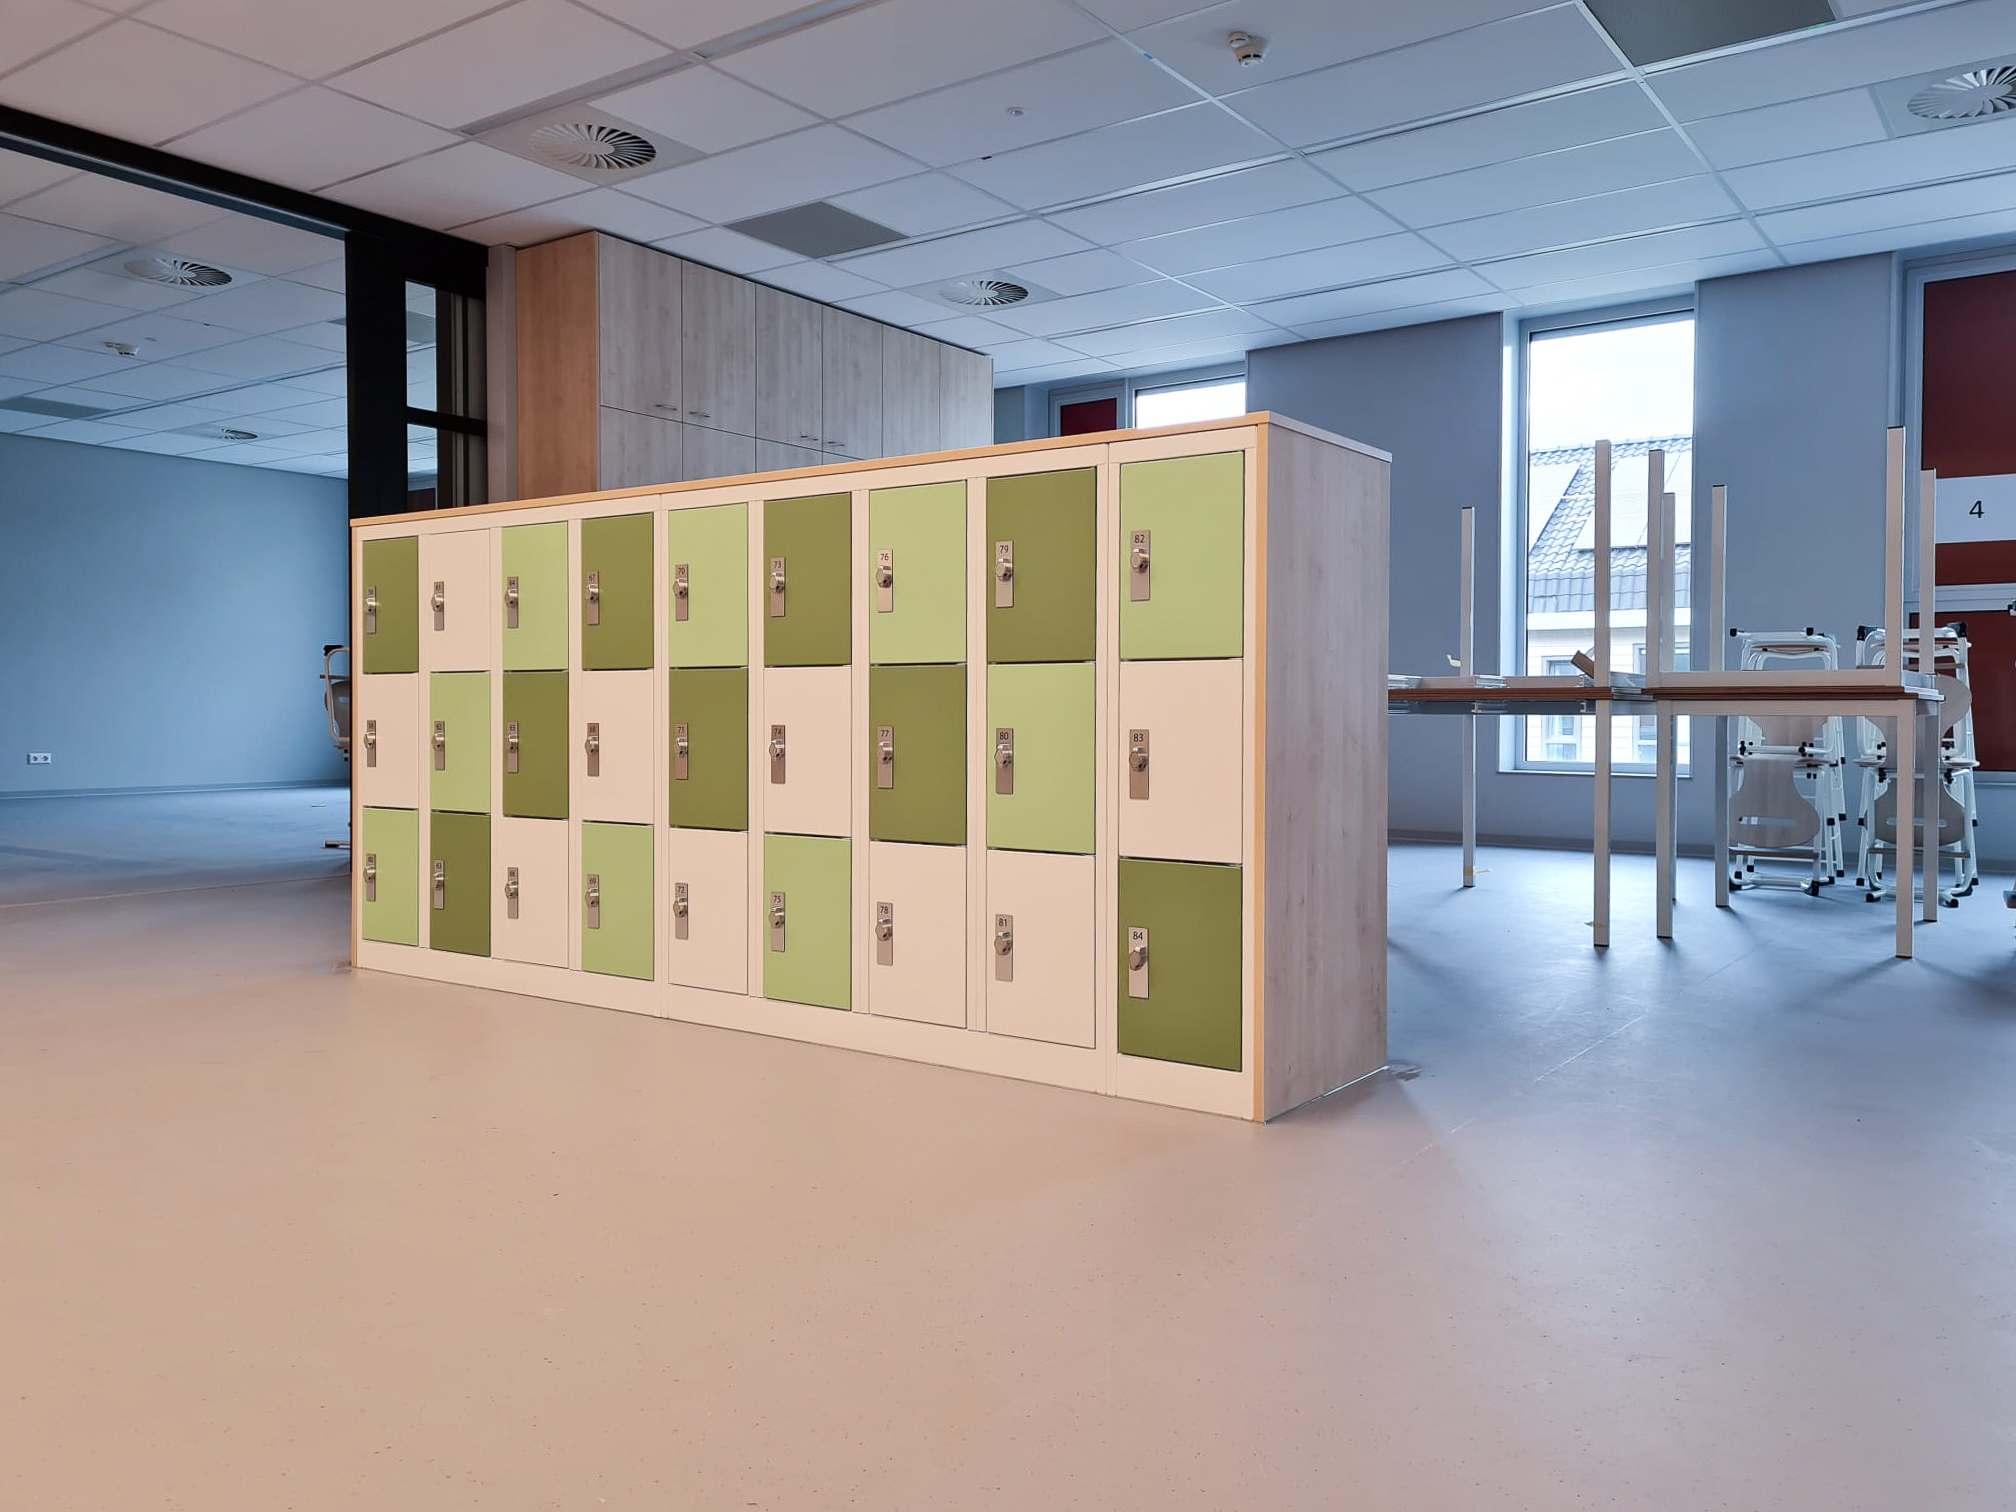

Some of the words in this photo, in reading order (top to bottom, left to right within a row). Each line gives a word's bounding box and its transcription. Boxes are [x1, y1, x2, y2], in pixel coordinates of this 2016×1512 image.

[1969, 500, 1985, 519] 4
[1134, 534, 1145, 543] 82
[999, 545, 1009, 554] 79
[880, 553, 889, 561] 76
[774, 560, 782, 568] 73
[678, 567, 685, 575] 70
[589, 573, 596, 581] 67
[774, 728, 781, 736] 74
[880, 729, 889, 737] 77
[999, 731, 1009, 740] 80
[1133, 733, 1144, 742] 83
[589, 877, 596, 885] 69
[774, 895, 782, 903] 75
[880, 906, 889, 914] 78
[998, 918, 1007, 927] 81
[1132, 931, 1143, 940] 84
